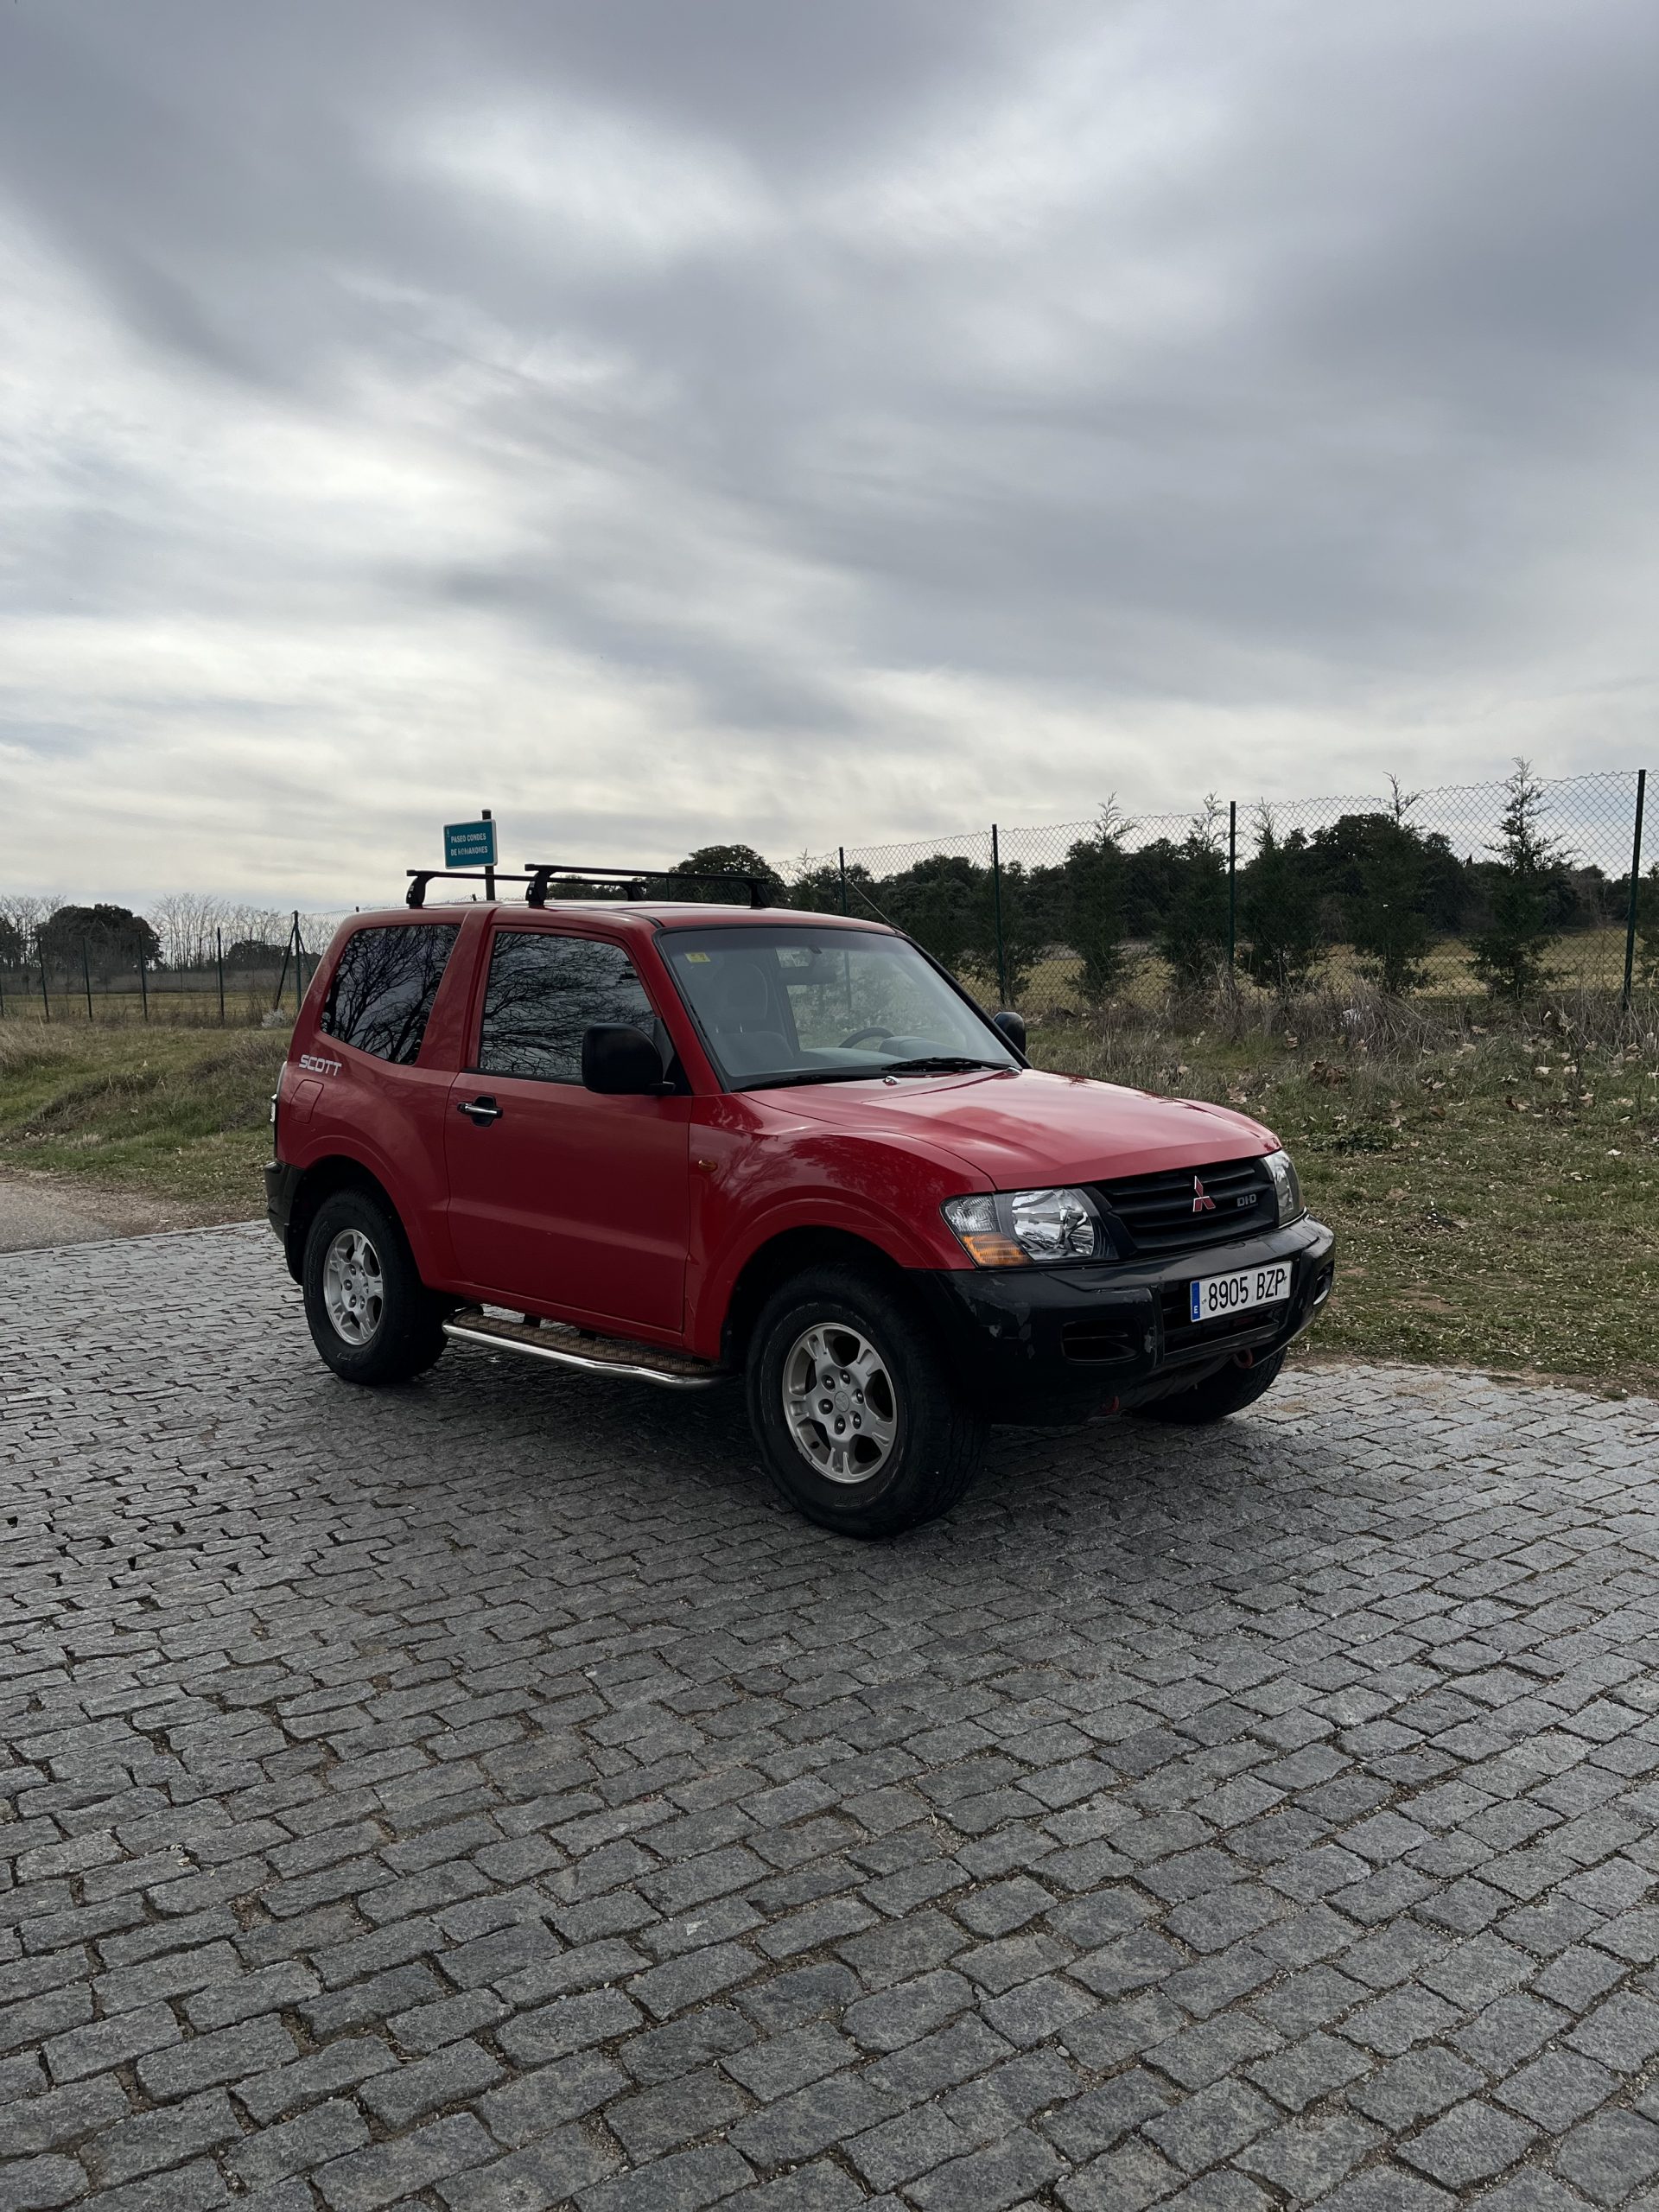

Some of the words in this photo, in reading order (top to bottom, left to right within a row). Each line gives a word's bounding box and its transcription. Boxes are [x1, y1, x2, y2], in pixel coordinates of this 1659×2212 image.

[450, 835, 467, 843] PASEO
[467, 833, 486, 842] CONDES
[298, 1054, 342, 1077] SCOTT
[1209, 1276, 1249, 1312] 8905
[1256, 1268, 1286, 1300] BZP
[1193, 1305, 1198, 1314] E
